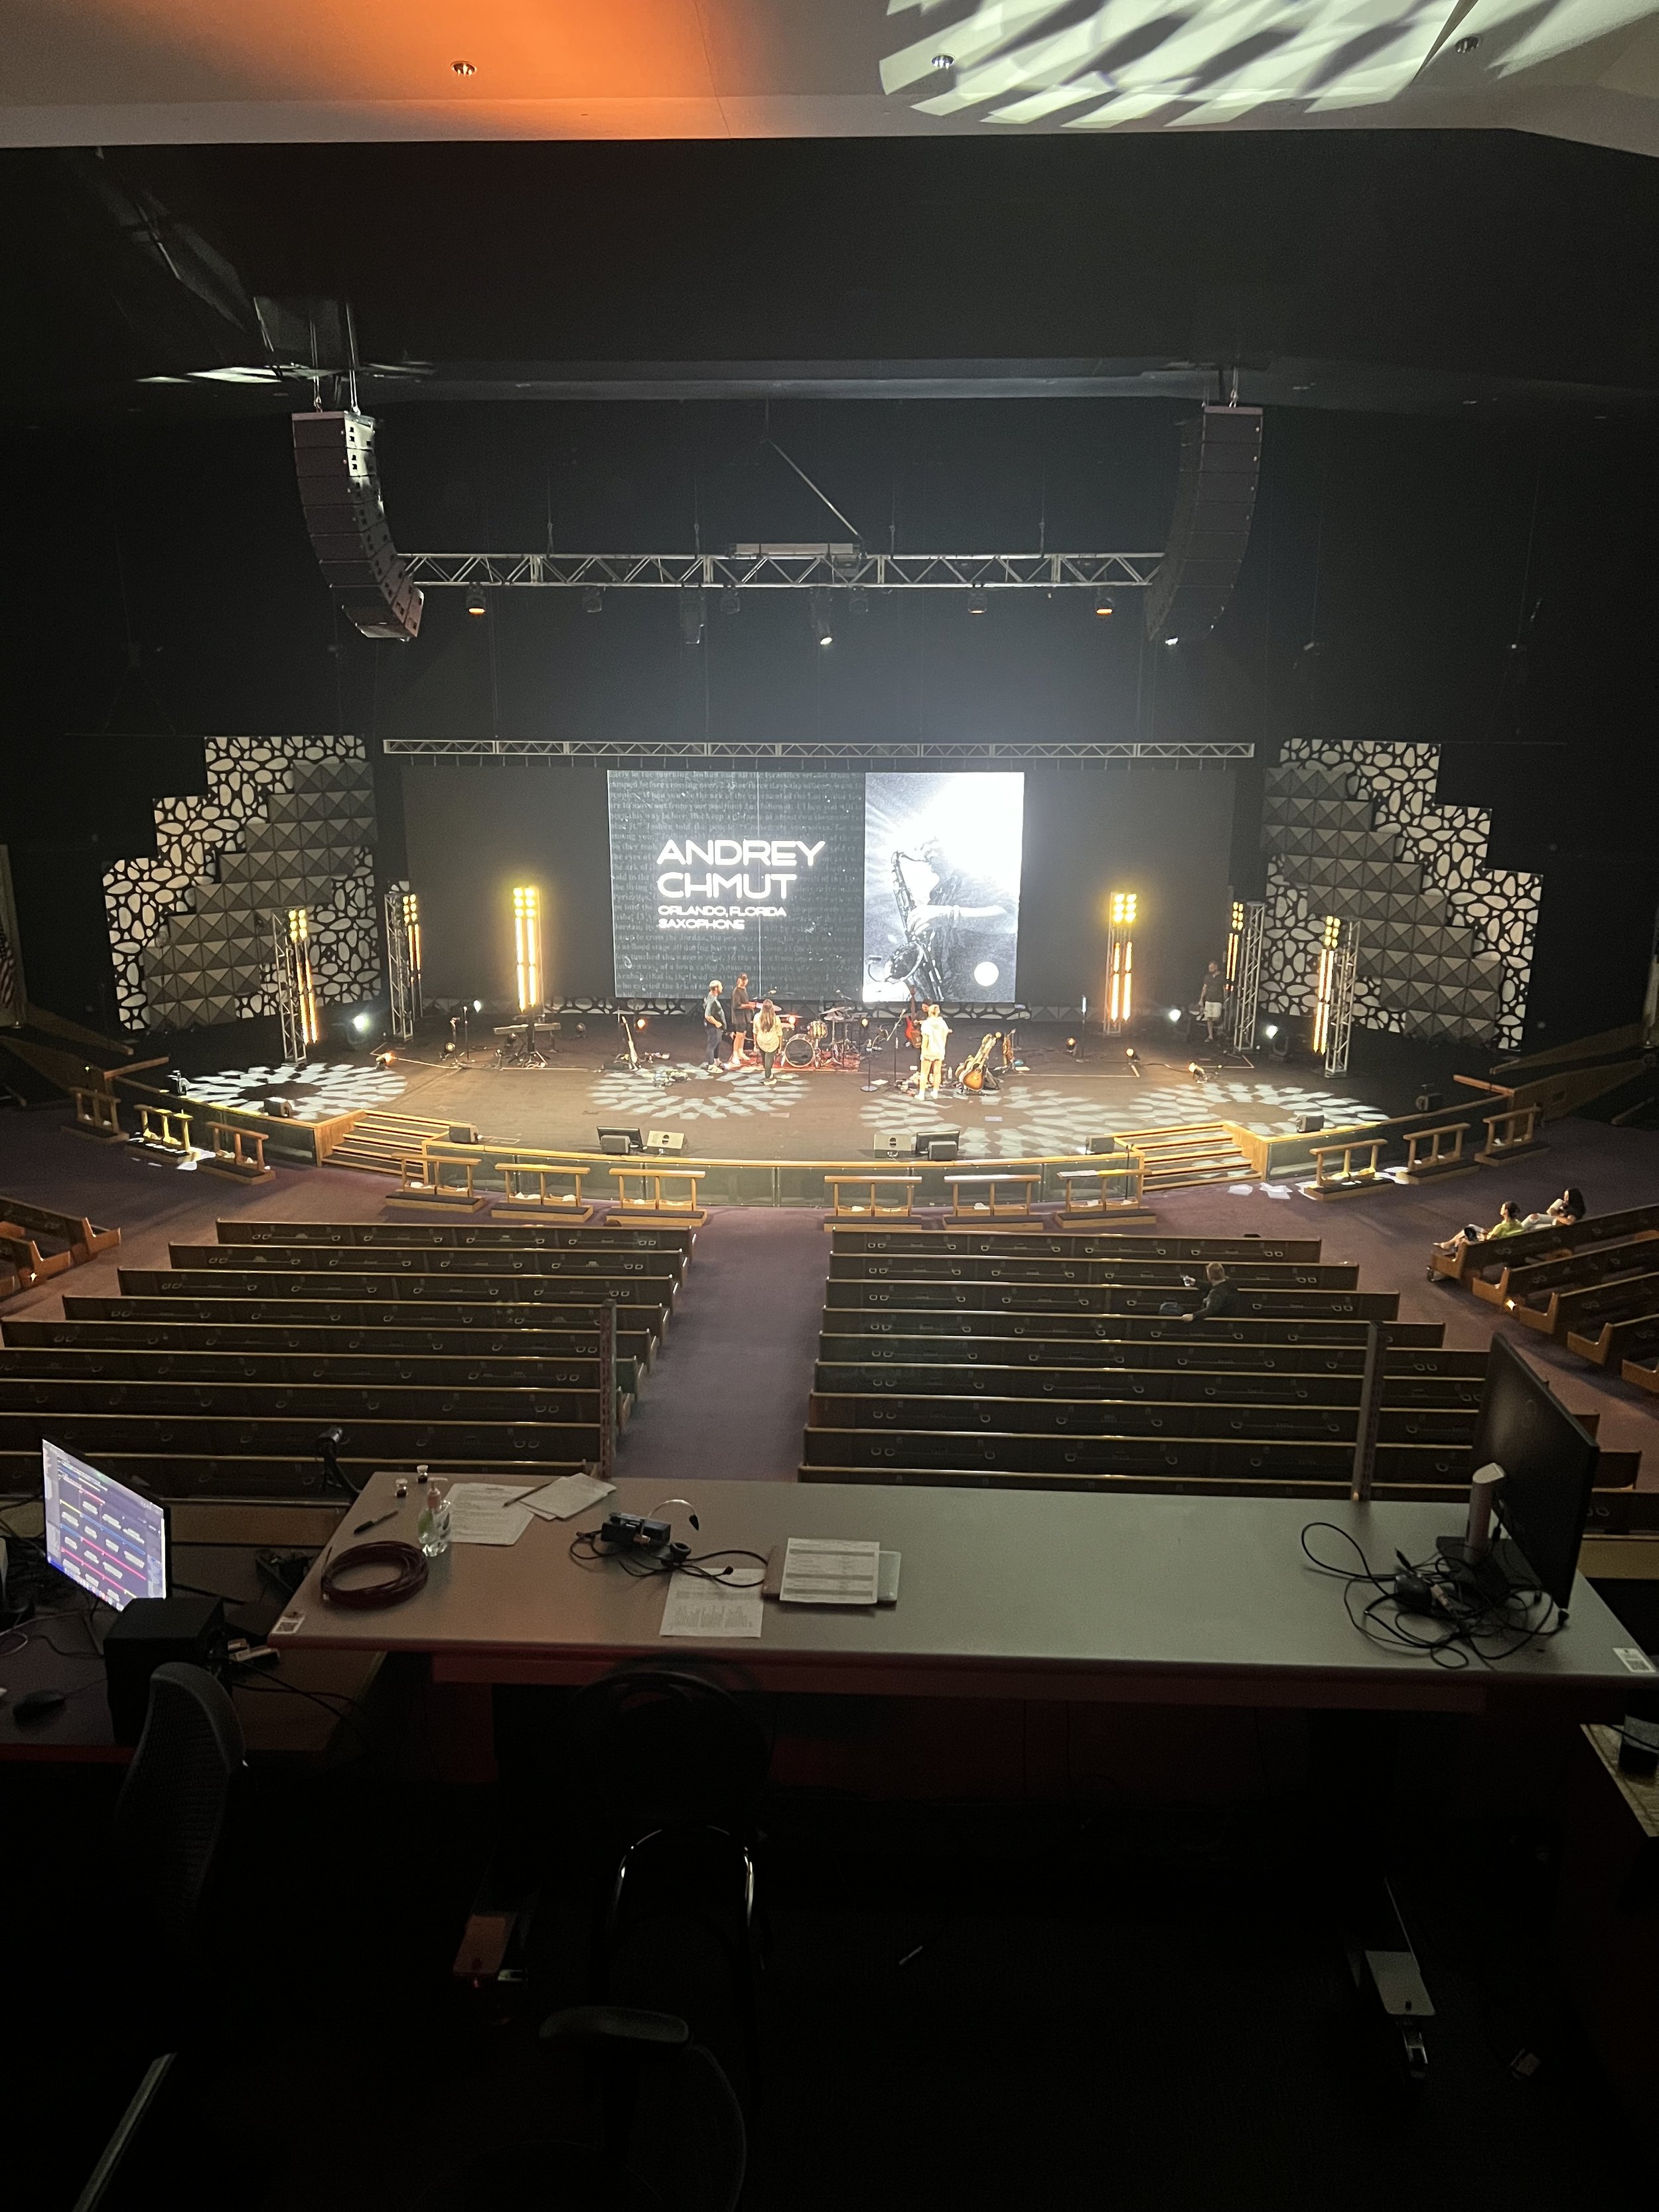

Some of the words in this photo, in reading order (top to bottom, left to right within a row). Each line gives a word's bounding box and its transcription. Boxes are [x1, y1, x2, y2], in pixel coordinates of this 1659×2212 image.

[656, 839, 826, 867] ANDREY
[656, 871, 797, 899] CHMUT
[658, 905, 729, 918] ORLANDO,
[729, 906, 786, 917] FLORIDA
[658, 919, 745, 930] SAXOPHONE
